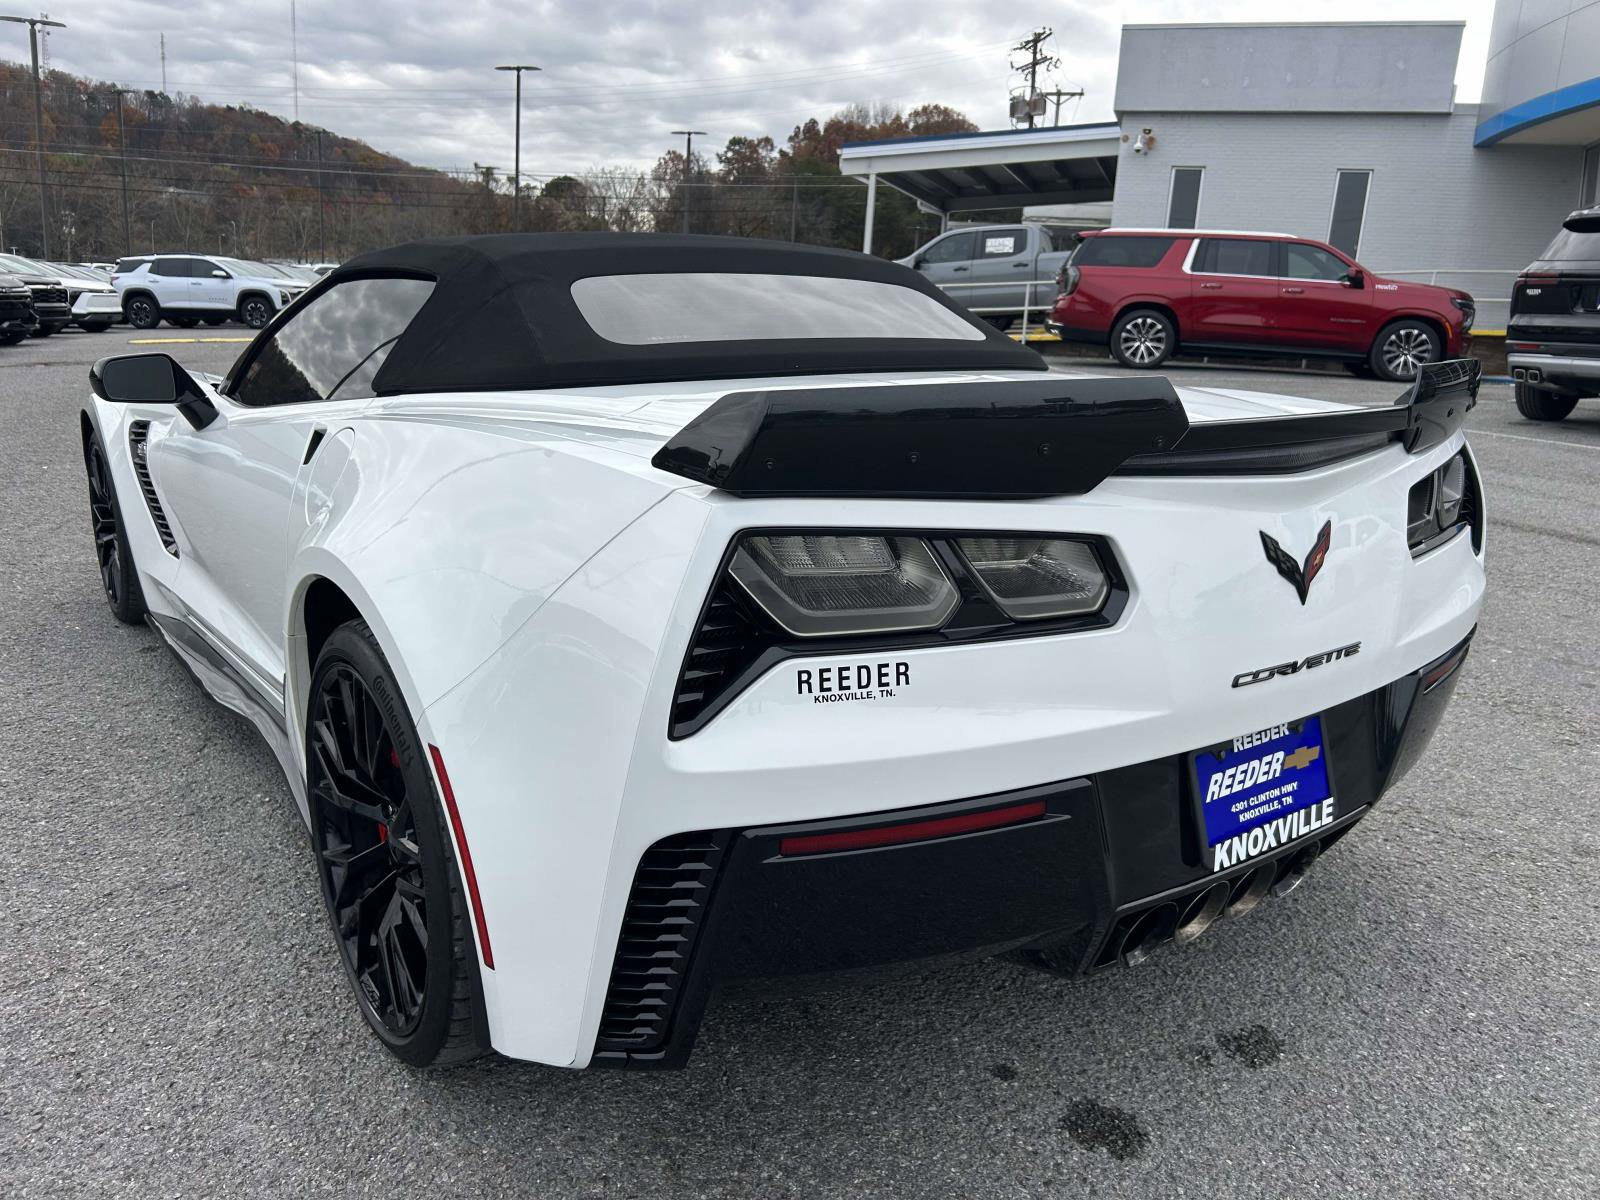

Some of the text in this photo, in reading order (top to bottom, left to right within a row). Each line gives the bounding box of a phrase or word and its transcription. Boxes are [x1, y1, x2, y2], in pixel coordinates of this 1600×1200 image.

[797, 662, 910, 695] REEDER
[1231, 640, 1362, 688] CORVETTE
[814, 688, 896, 704] KNOXVILLE, TN.
[1232, 722, 1290, 753] REEDER
[1205, 750, 1285, 804] REEDER
[1230, 781, 1299, 813] 4301 CLINTON HWY
[1239, 795, 1293, 823] KNOXVILLE, TN
[1213, 796, 1334, 873] KNOXVILLE
